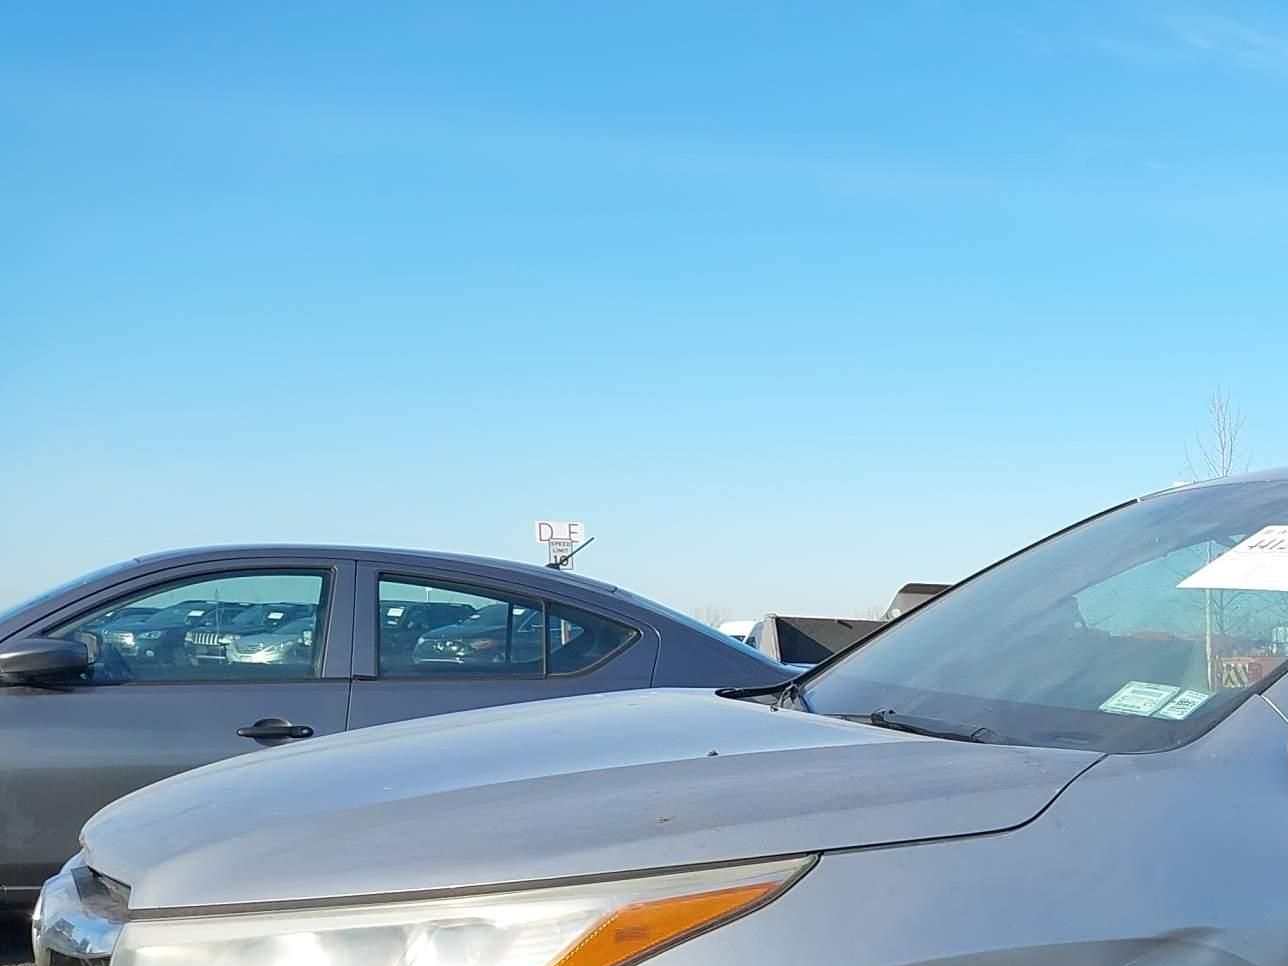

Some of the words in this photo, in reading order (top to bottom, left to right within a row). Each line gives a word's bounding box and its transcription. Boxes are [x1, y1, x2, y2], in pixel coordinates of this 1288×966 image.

[539, 522, 554, 542] D
[568, 523, 580, 543] E
[553, 555, 569, 567] 10
